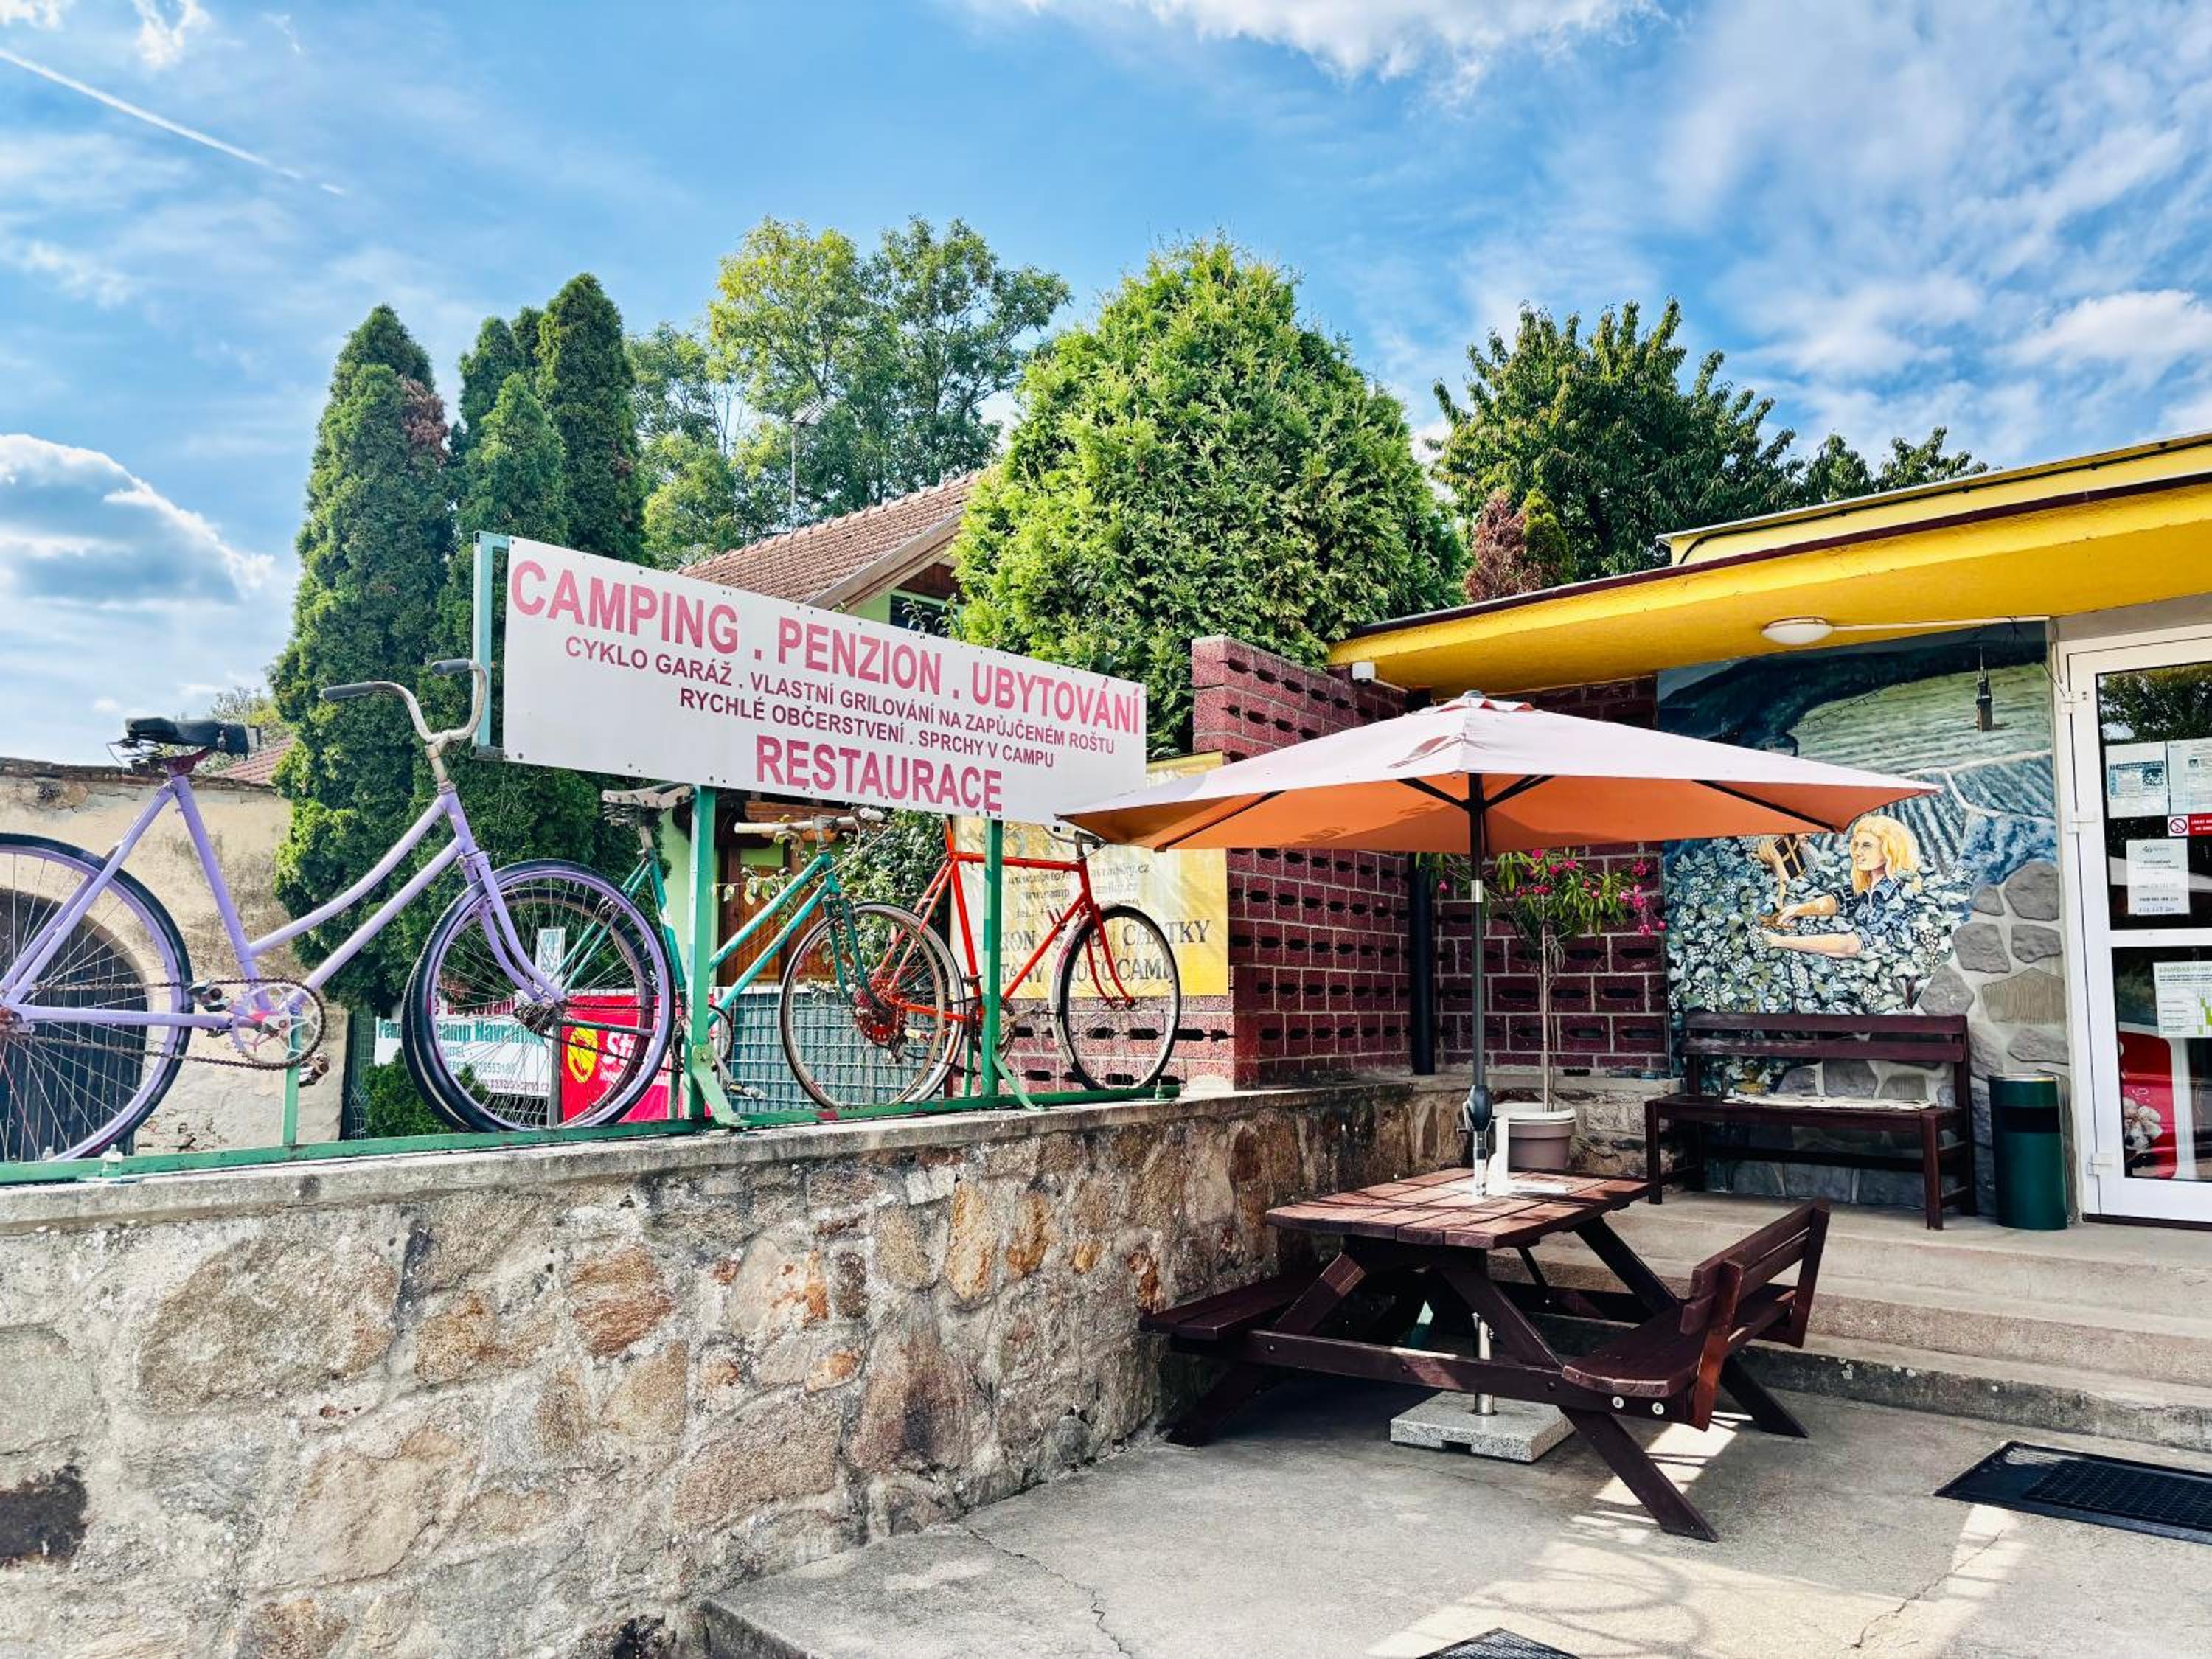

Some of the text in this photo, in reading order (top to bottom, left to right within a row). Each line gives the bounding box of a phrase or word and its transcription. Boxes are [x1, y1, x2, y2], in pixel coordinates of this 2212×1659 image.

[512, 560, 739, 655] CAMPING
[778, 616, 942, 697] PENZION
[971, 661, 1140, 735] UBYTOVÁNÍ
[566, 636, 647, 669] CYKLO
[655, 653, 732, 686] GARÁŽ
[750, 672, 834, 705] VLASTNÍ
[840, 689, 934, 724] GRILOVÁNÍ
[939, 710, 961, 728] NA
[965, 714, 1065, 745] ZAPŮJČENÉM
[1069, 731, 1115, 754] ROŠTU
[680, 687, 765, 720] RYCHLÉ
[772, 703, 905, 745] OBČERSTVENÍ
[919, 730, 984, 759] SPRCHY
[988, 742, 998, 759] V
[1002, 745, 1054, 768] CAMPU
[755, 733, 1004, 813] RESTAURACE
